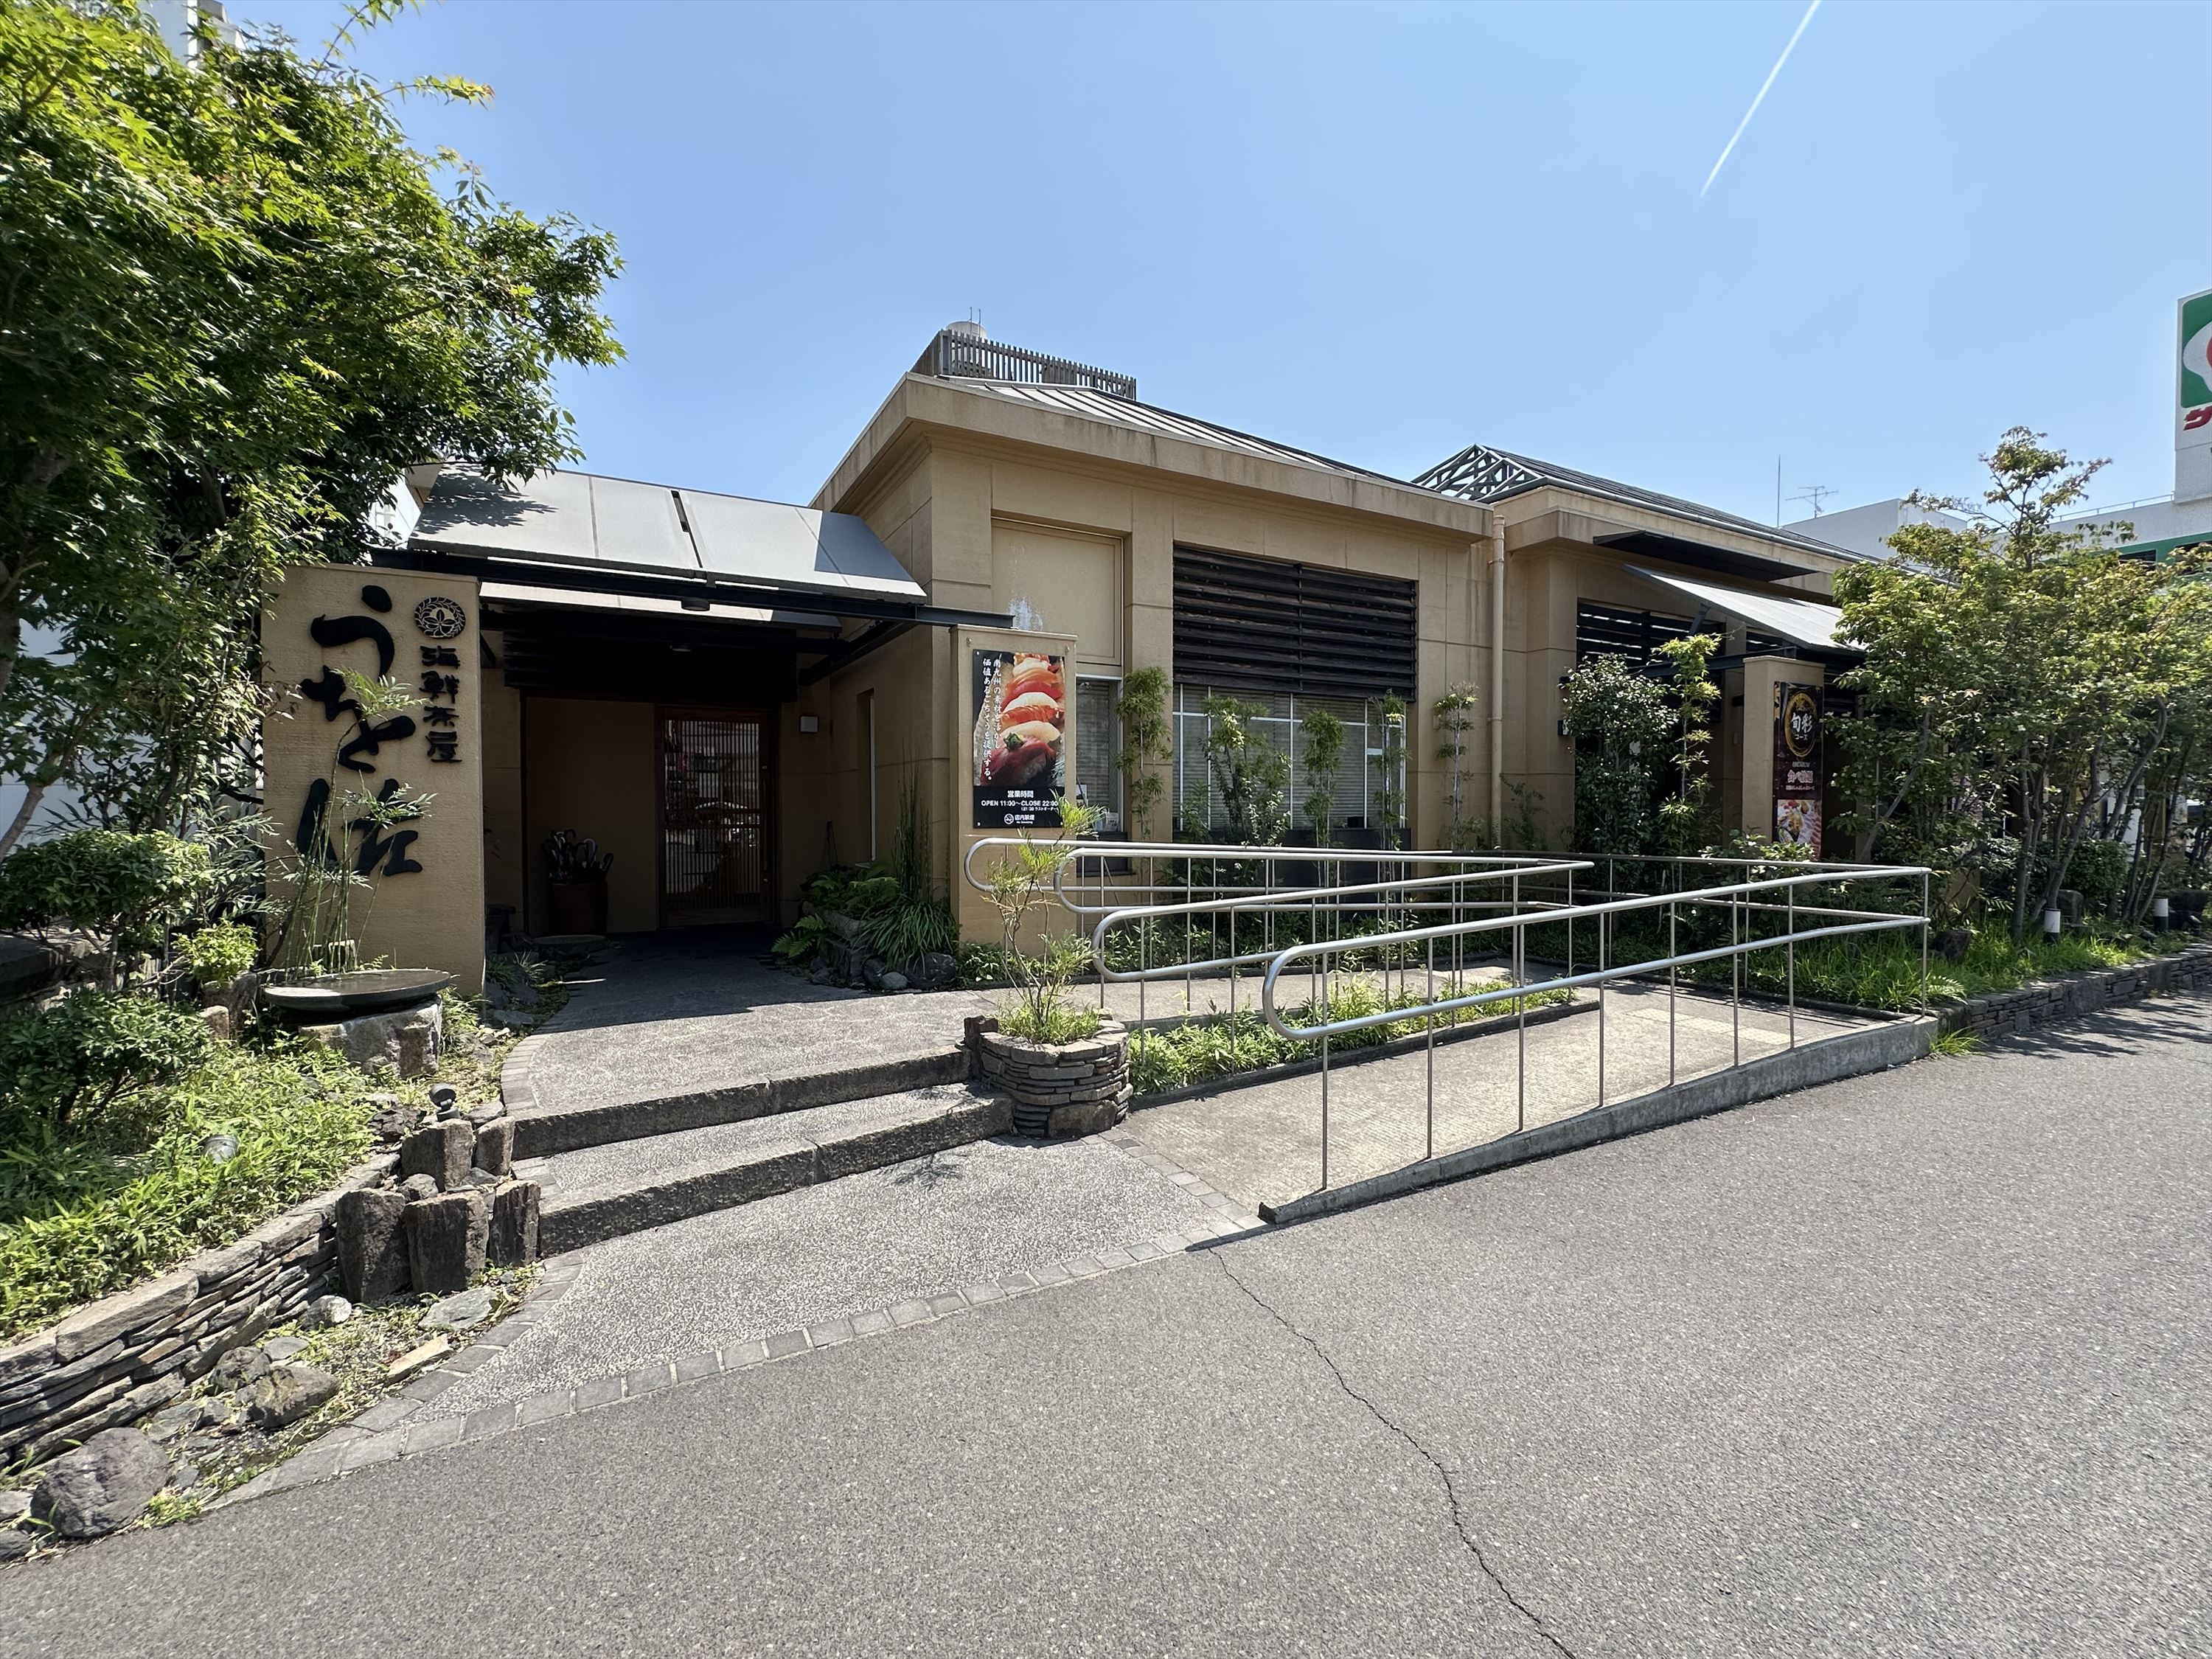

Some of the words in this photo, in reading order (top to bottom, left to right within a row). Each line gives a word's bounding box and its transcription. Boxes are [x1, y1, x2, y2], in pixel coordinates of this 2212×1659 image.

[420, 645, 462, 763] 海鮮茶屋
[1790, 712, 1813, 734] 旬彩
[1007, 790, 1034, 798] 営業時間
